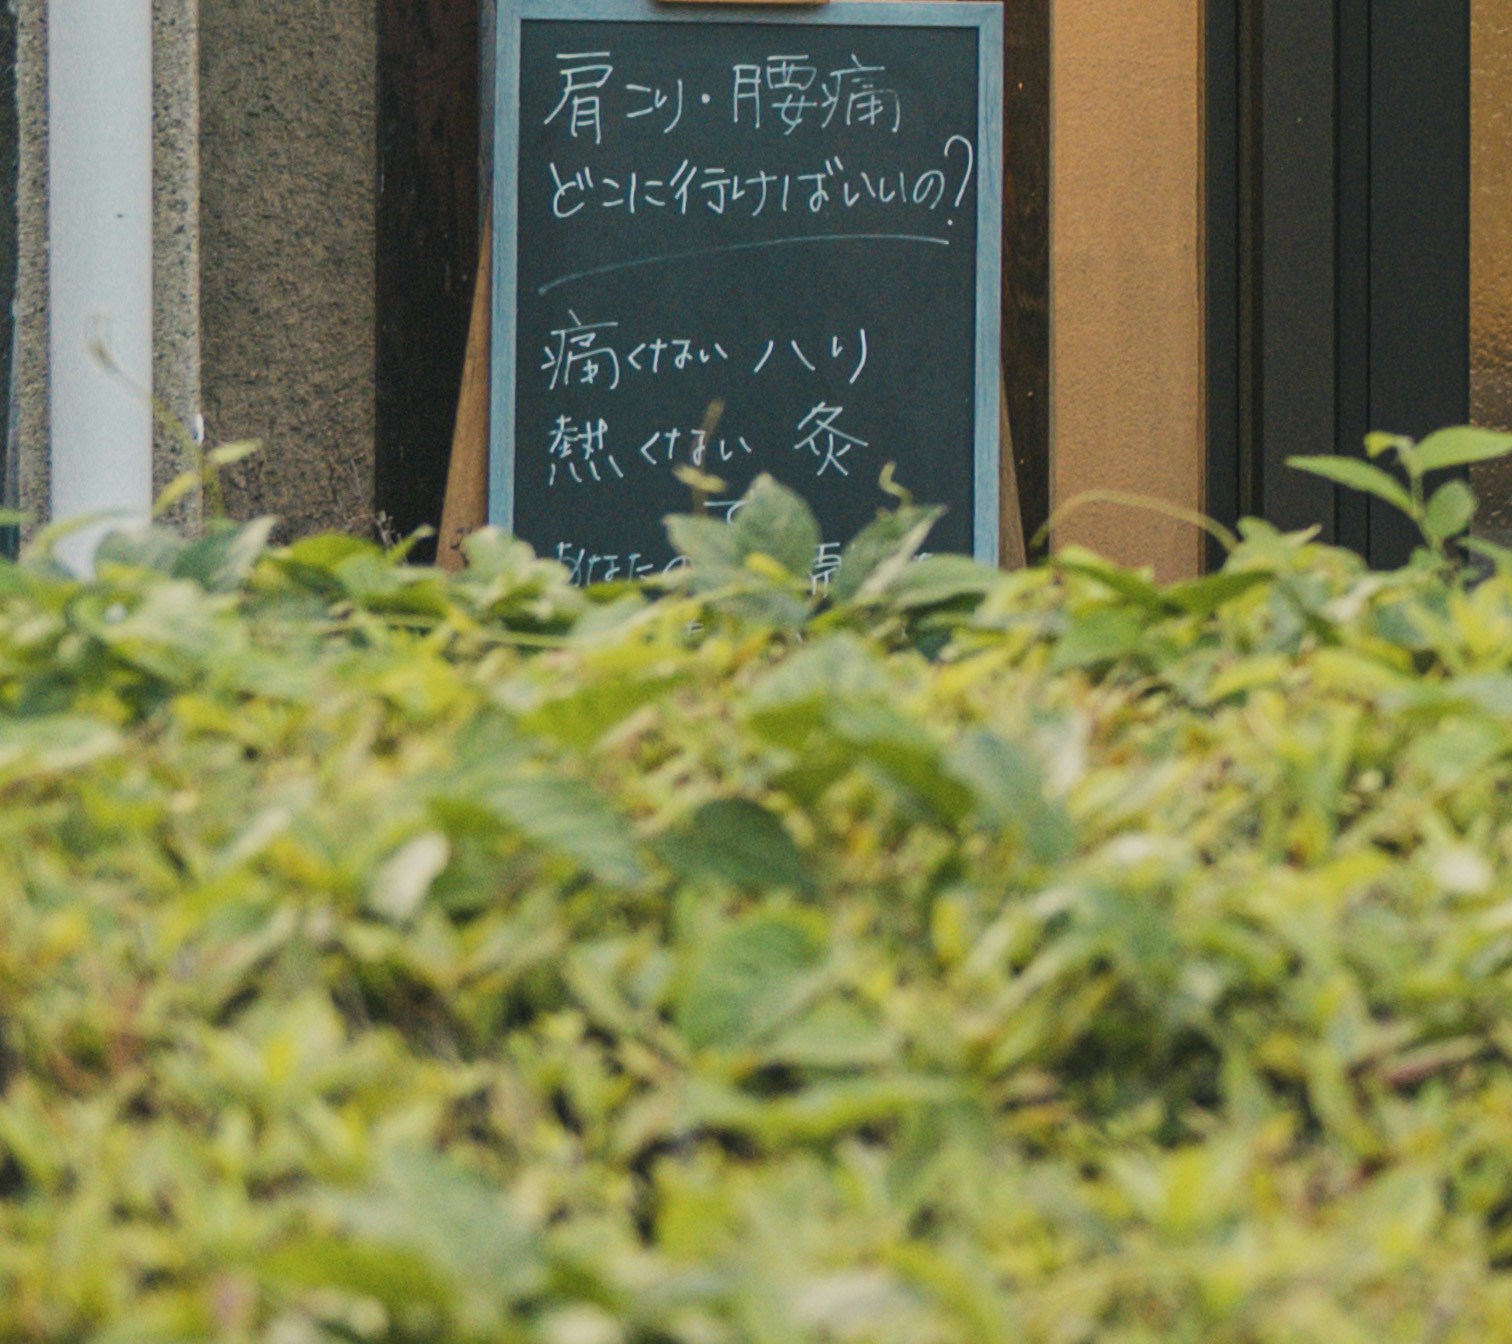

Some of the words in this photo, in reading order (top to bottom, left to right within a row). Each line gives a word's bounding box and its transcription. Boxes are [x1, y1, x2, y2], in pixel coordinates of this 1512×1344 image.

[543, 51, 901, 145] 肩こり・腰痛
